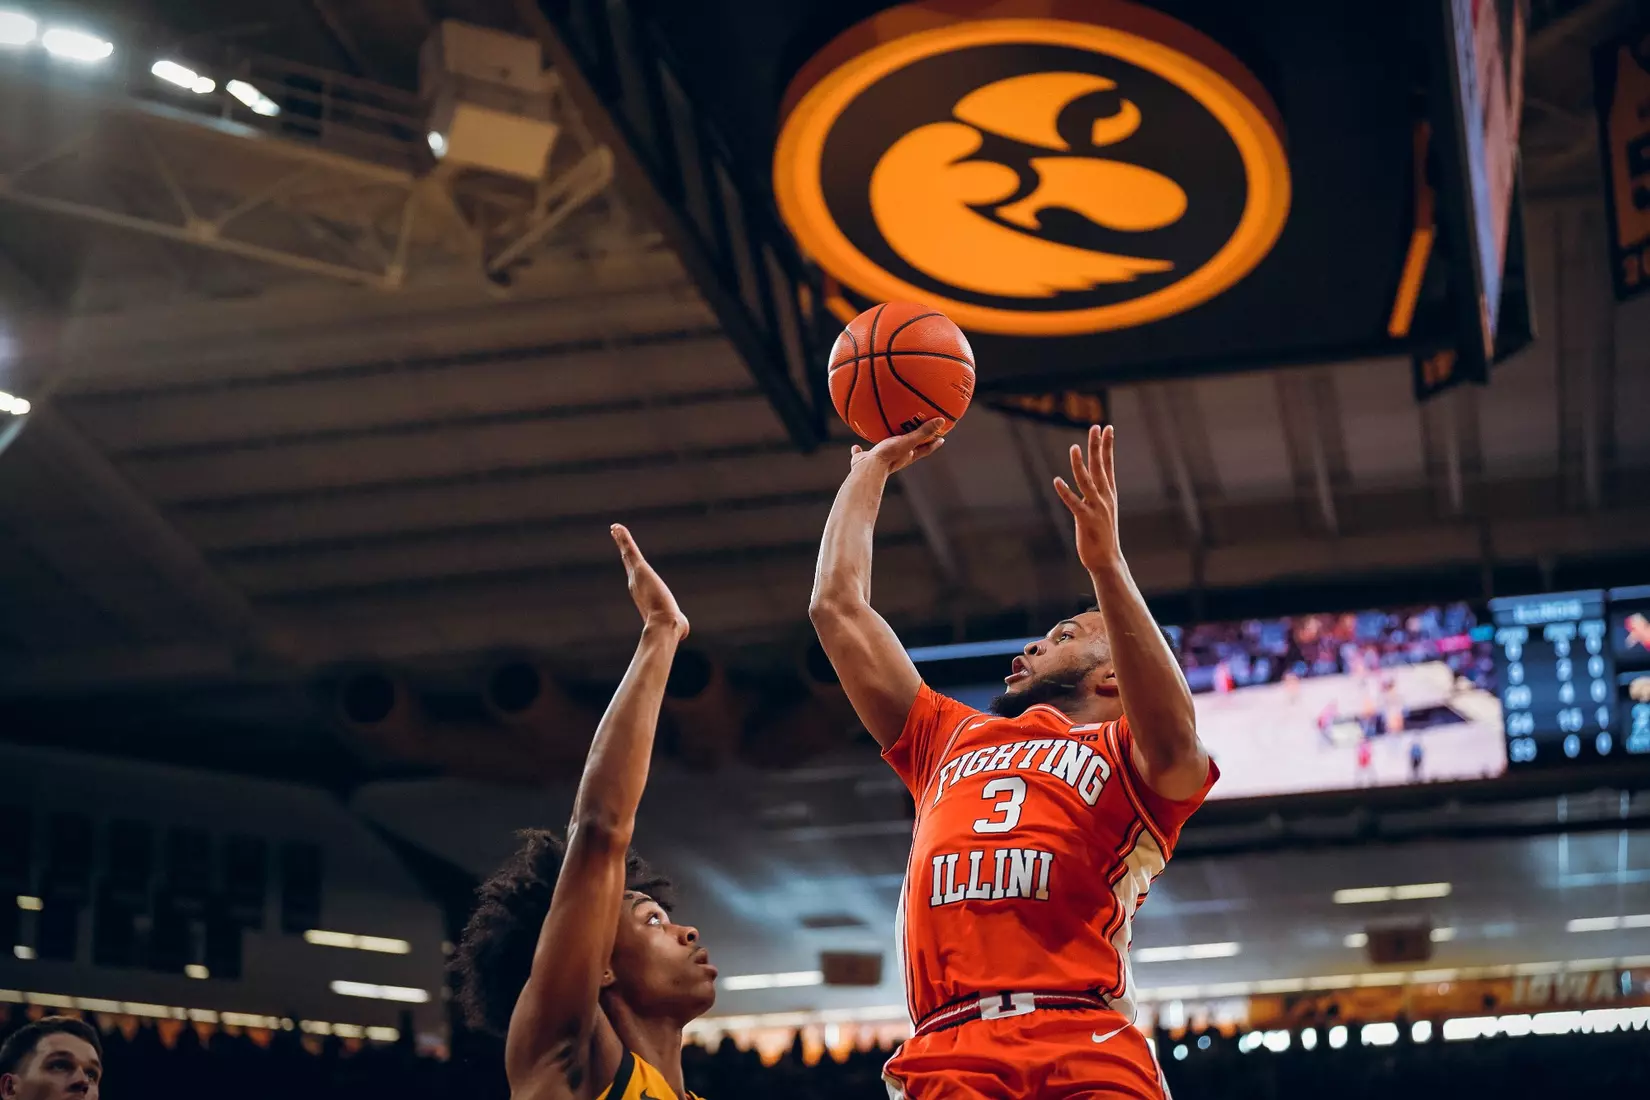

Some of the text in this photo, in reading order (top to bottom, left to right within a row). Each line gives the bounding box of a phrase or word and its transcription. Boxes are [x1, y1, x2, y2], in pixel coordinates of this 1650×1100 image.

[932, 739, 1112, 808] FIGHTING
[972, 776, 1027, 834] 3
[929, 848, 1054, 907] ILLINI
